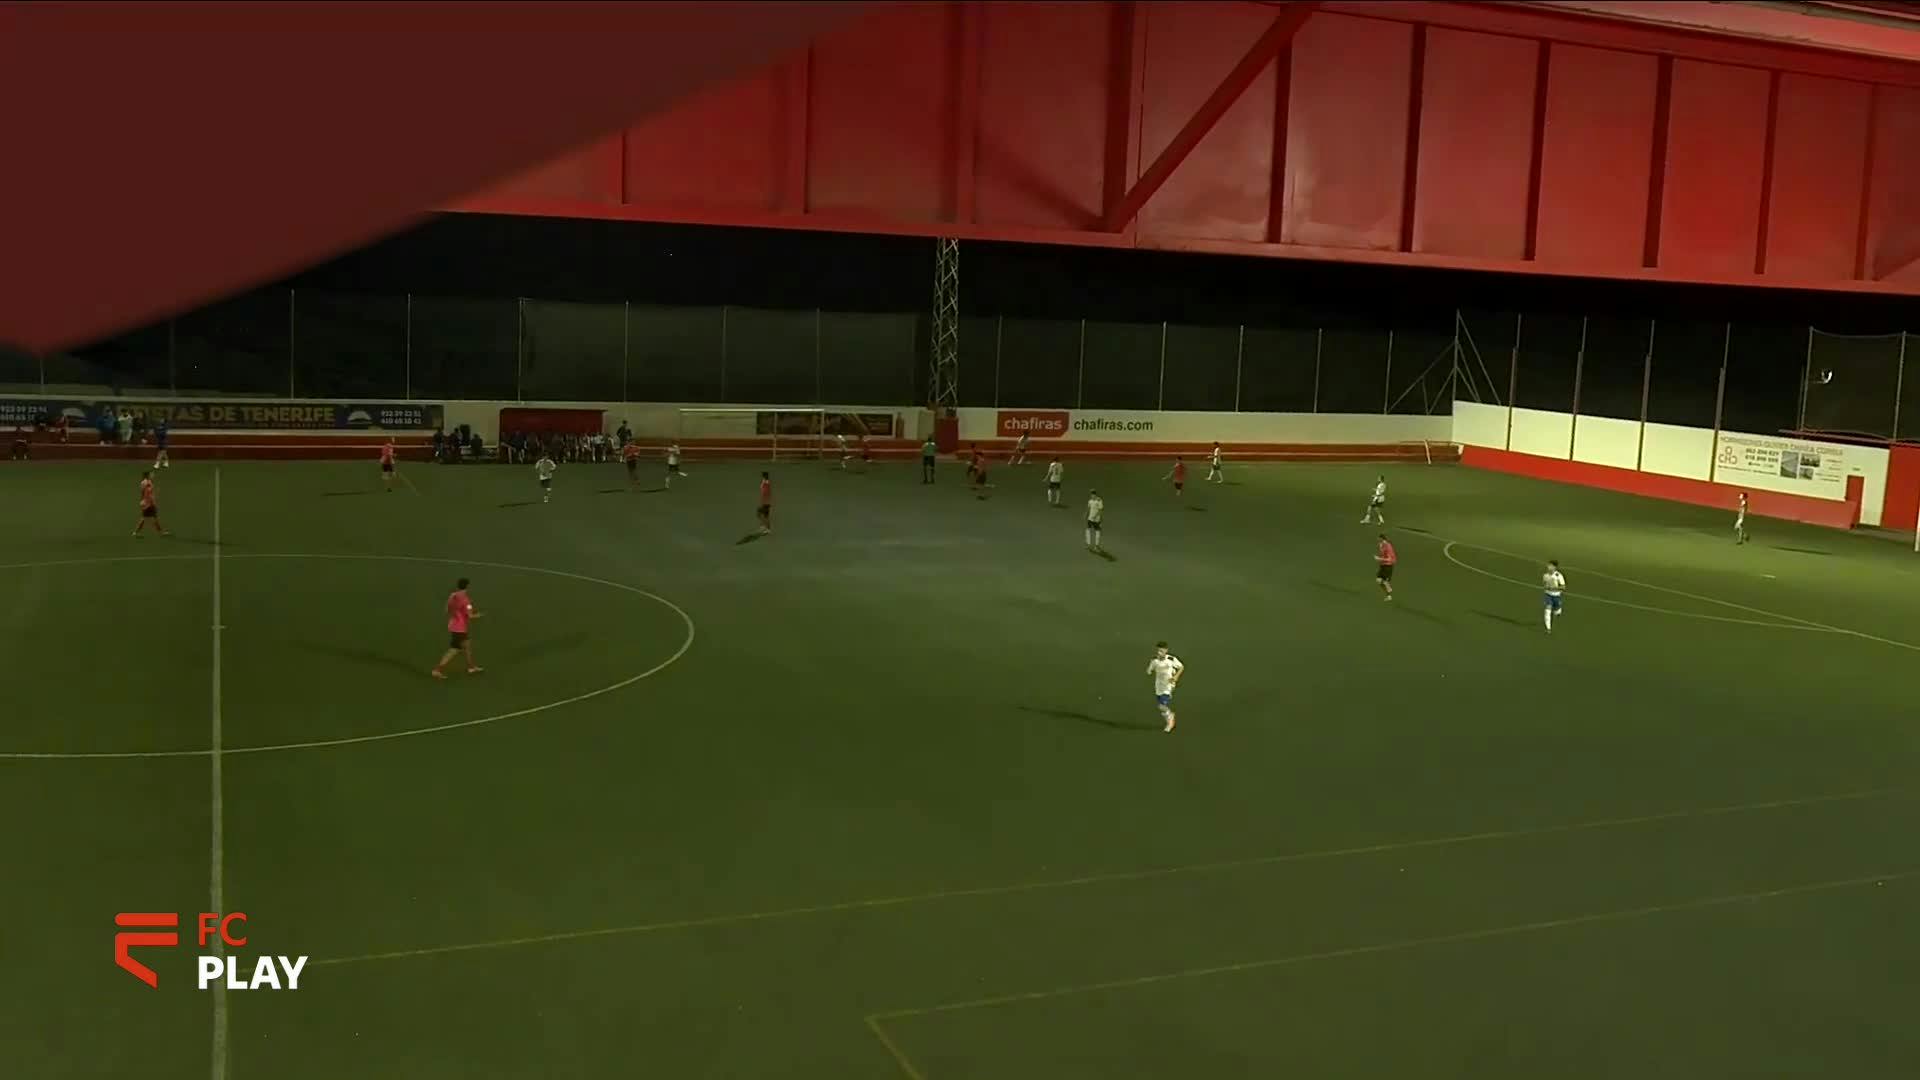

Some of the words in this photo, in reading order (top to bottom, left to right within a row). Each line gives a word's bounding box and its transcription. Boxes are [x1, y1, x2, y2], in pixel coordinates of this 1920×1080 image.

[209, 406, 236, 422] DE
[239, 406, 336, 422] TENERIFE
[1004, 417, 1062, 430] chafiras
[1073, 419, 1153, 431] chafiras.com
